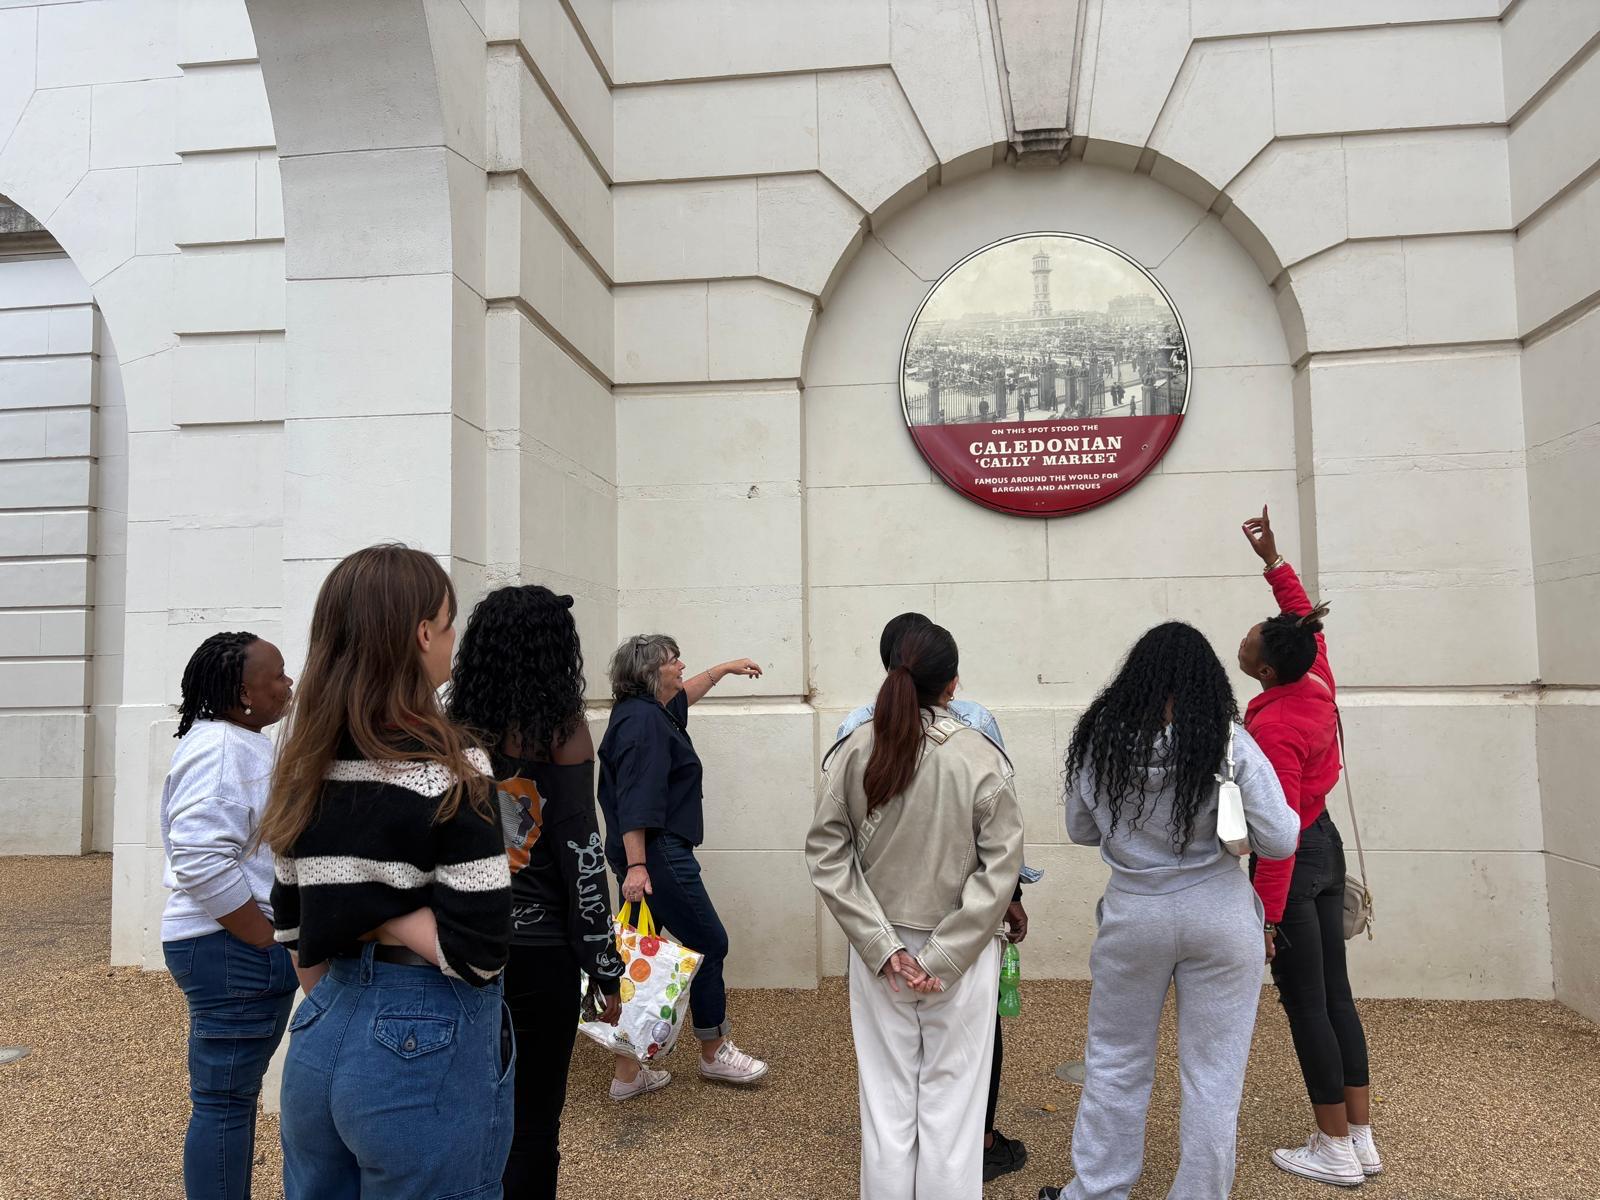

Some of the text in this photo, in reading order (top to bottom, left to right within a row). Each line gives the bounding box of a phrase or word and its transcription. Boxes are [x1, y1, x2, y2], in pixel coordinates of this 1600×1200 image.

[969, 436, 1123, 456] CALEDONIAN
[1042, 452, 1117, 466] MARKET
[974, 477, 1009, 485] FAMOUS
[1010, 475, 1047, 483] AROUND
[1049, 474, 1067, 482] THE
[1068, 473, 1100, 481] WORLD
[992, 485, 1035, 493] BARGAINS
[1057, 483, 1101, 491] ANTIQUES
